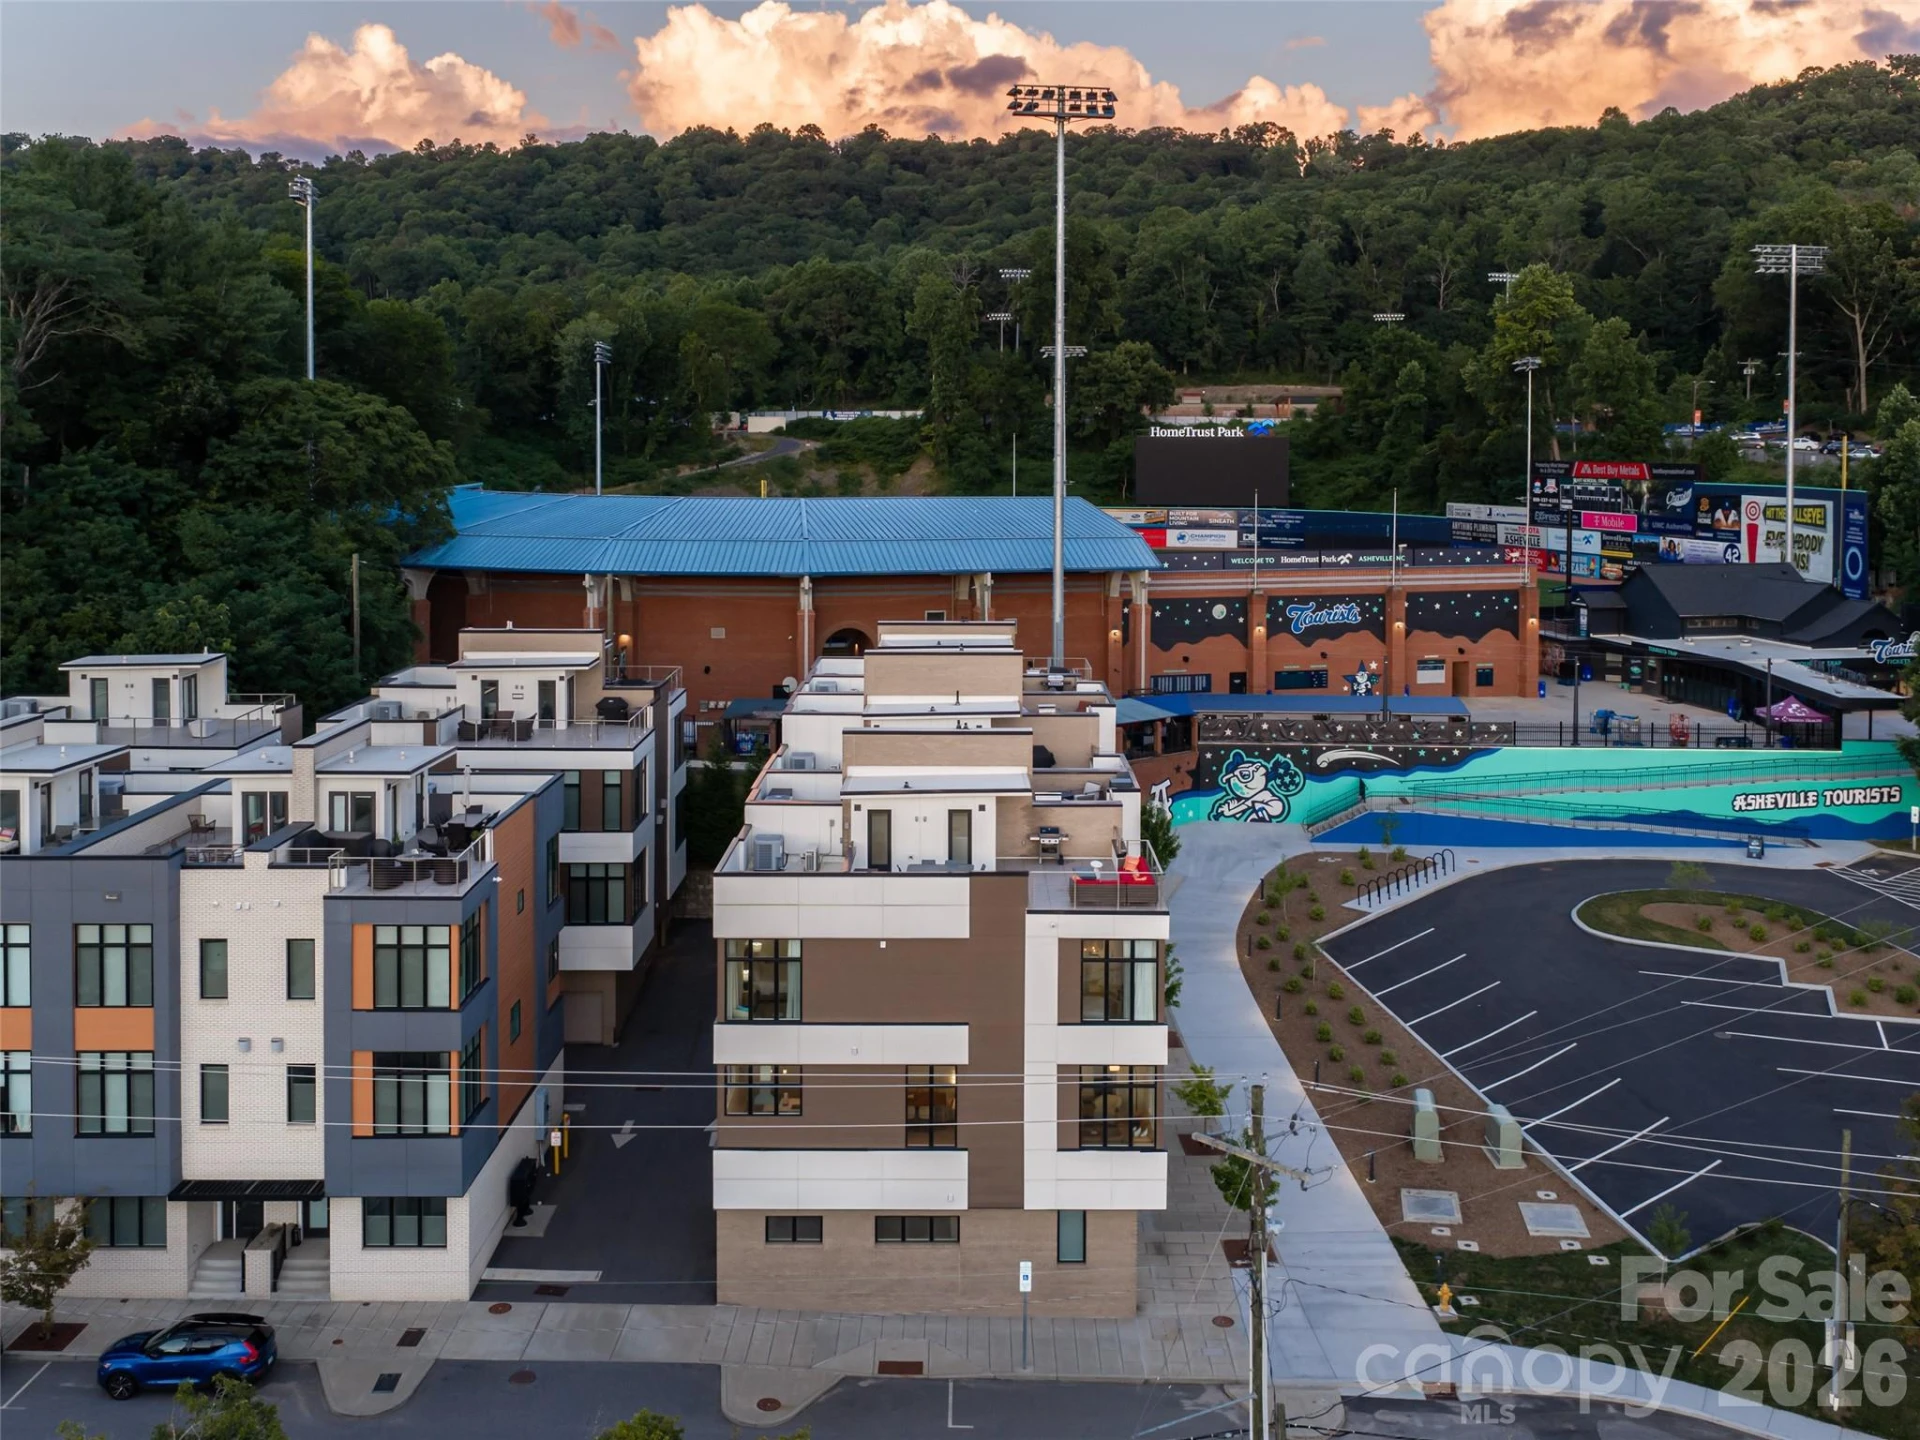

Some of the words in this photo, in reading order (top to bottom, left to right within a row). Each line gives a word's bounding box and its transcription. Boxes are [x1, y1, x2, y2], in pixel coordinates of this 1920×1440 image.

[1150, 426, 1215, 437] HomeTrust
[1217, 426, 1244, 437] Park
[1593, 464, 1607, 474] Best
[1607, 465, 1619, 476] Buy
[1619, 465, 1640, 475] Metals
[1601, 516, 1625, 528] Mobile
[1790, 507, 1825, 525] LLSEYE!
[1518, 526, 1540, 534] TOOTA
[1765, 530, 1824, 555] EVEYBODY
[1281, 555, 1319, 563] HomeTrust
[1321, 555, 1337, 563] Park
[1724, 548, 1739, 563] 42
[1286, 602, 1361, 634] Tourists
[1871, 637, 1918, 664] Touri
[1733, 791, 1818, 811] ASHEVILLE
[1823, 786, 1901, 806] TOURISTS
